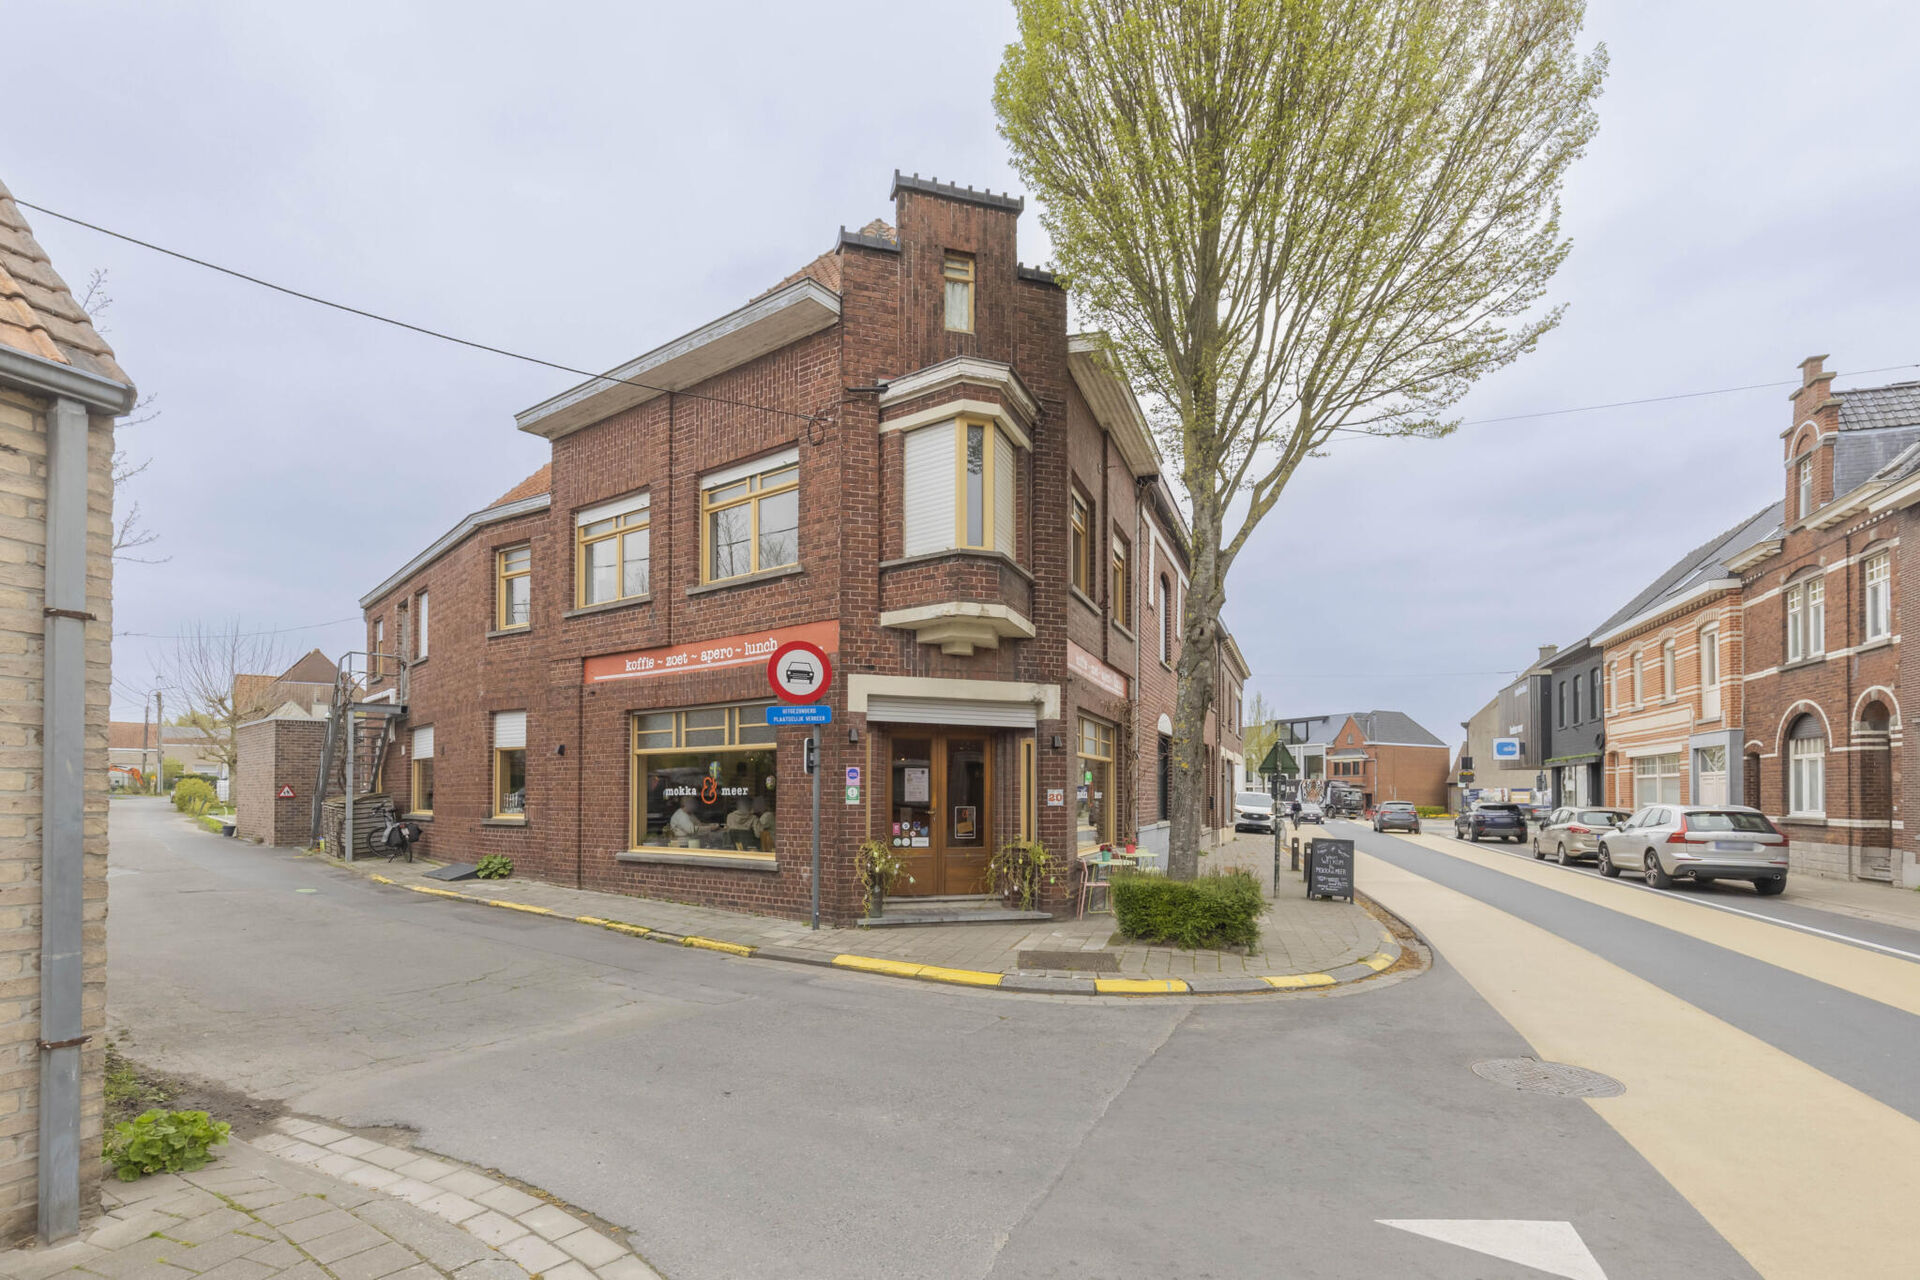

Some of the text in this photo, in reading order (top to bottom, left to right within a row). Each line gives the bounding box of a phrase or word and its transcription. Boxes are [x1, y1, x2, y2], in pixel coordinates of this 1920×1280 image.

[625, 656, 654, 671] koffie
[665, 652, 688, 667] zoet
[700, 646, 732, 663] apero
[744, 637, 778, 655] lunch
[665, 776, 749, 804] mokka & meer
[1048, 793, 1063, 802] 20
